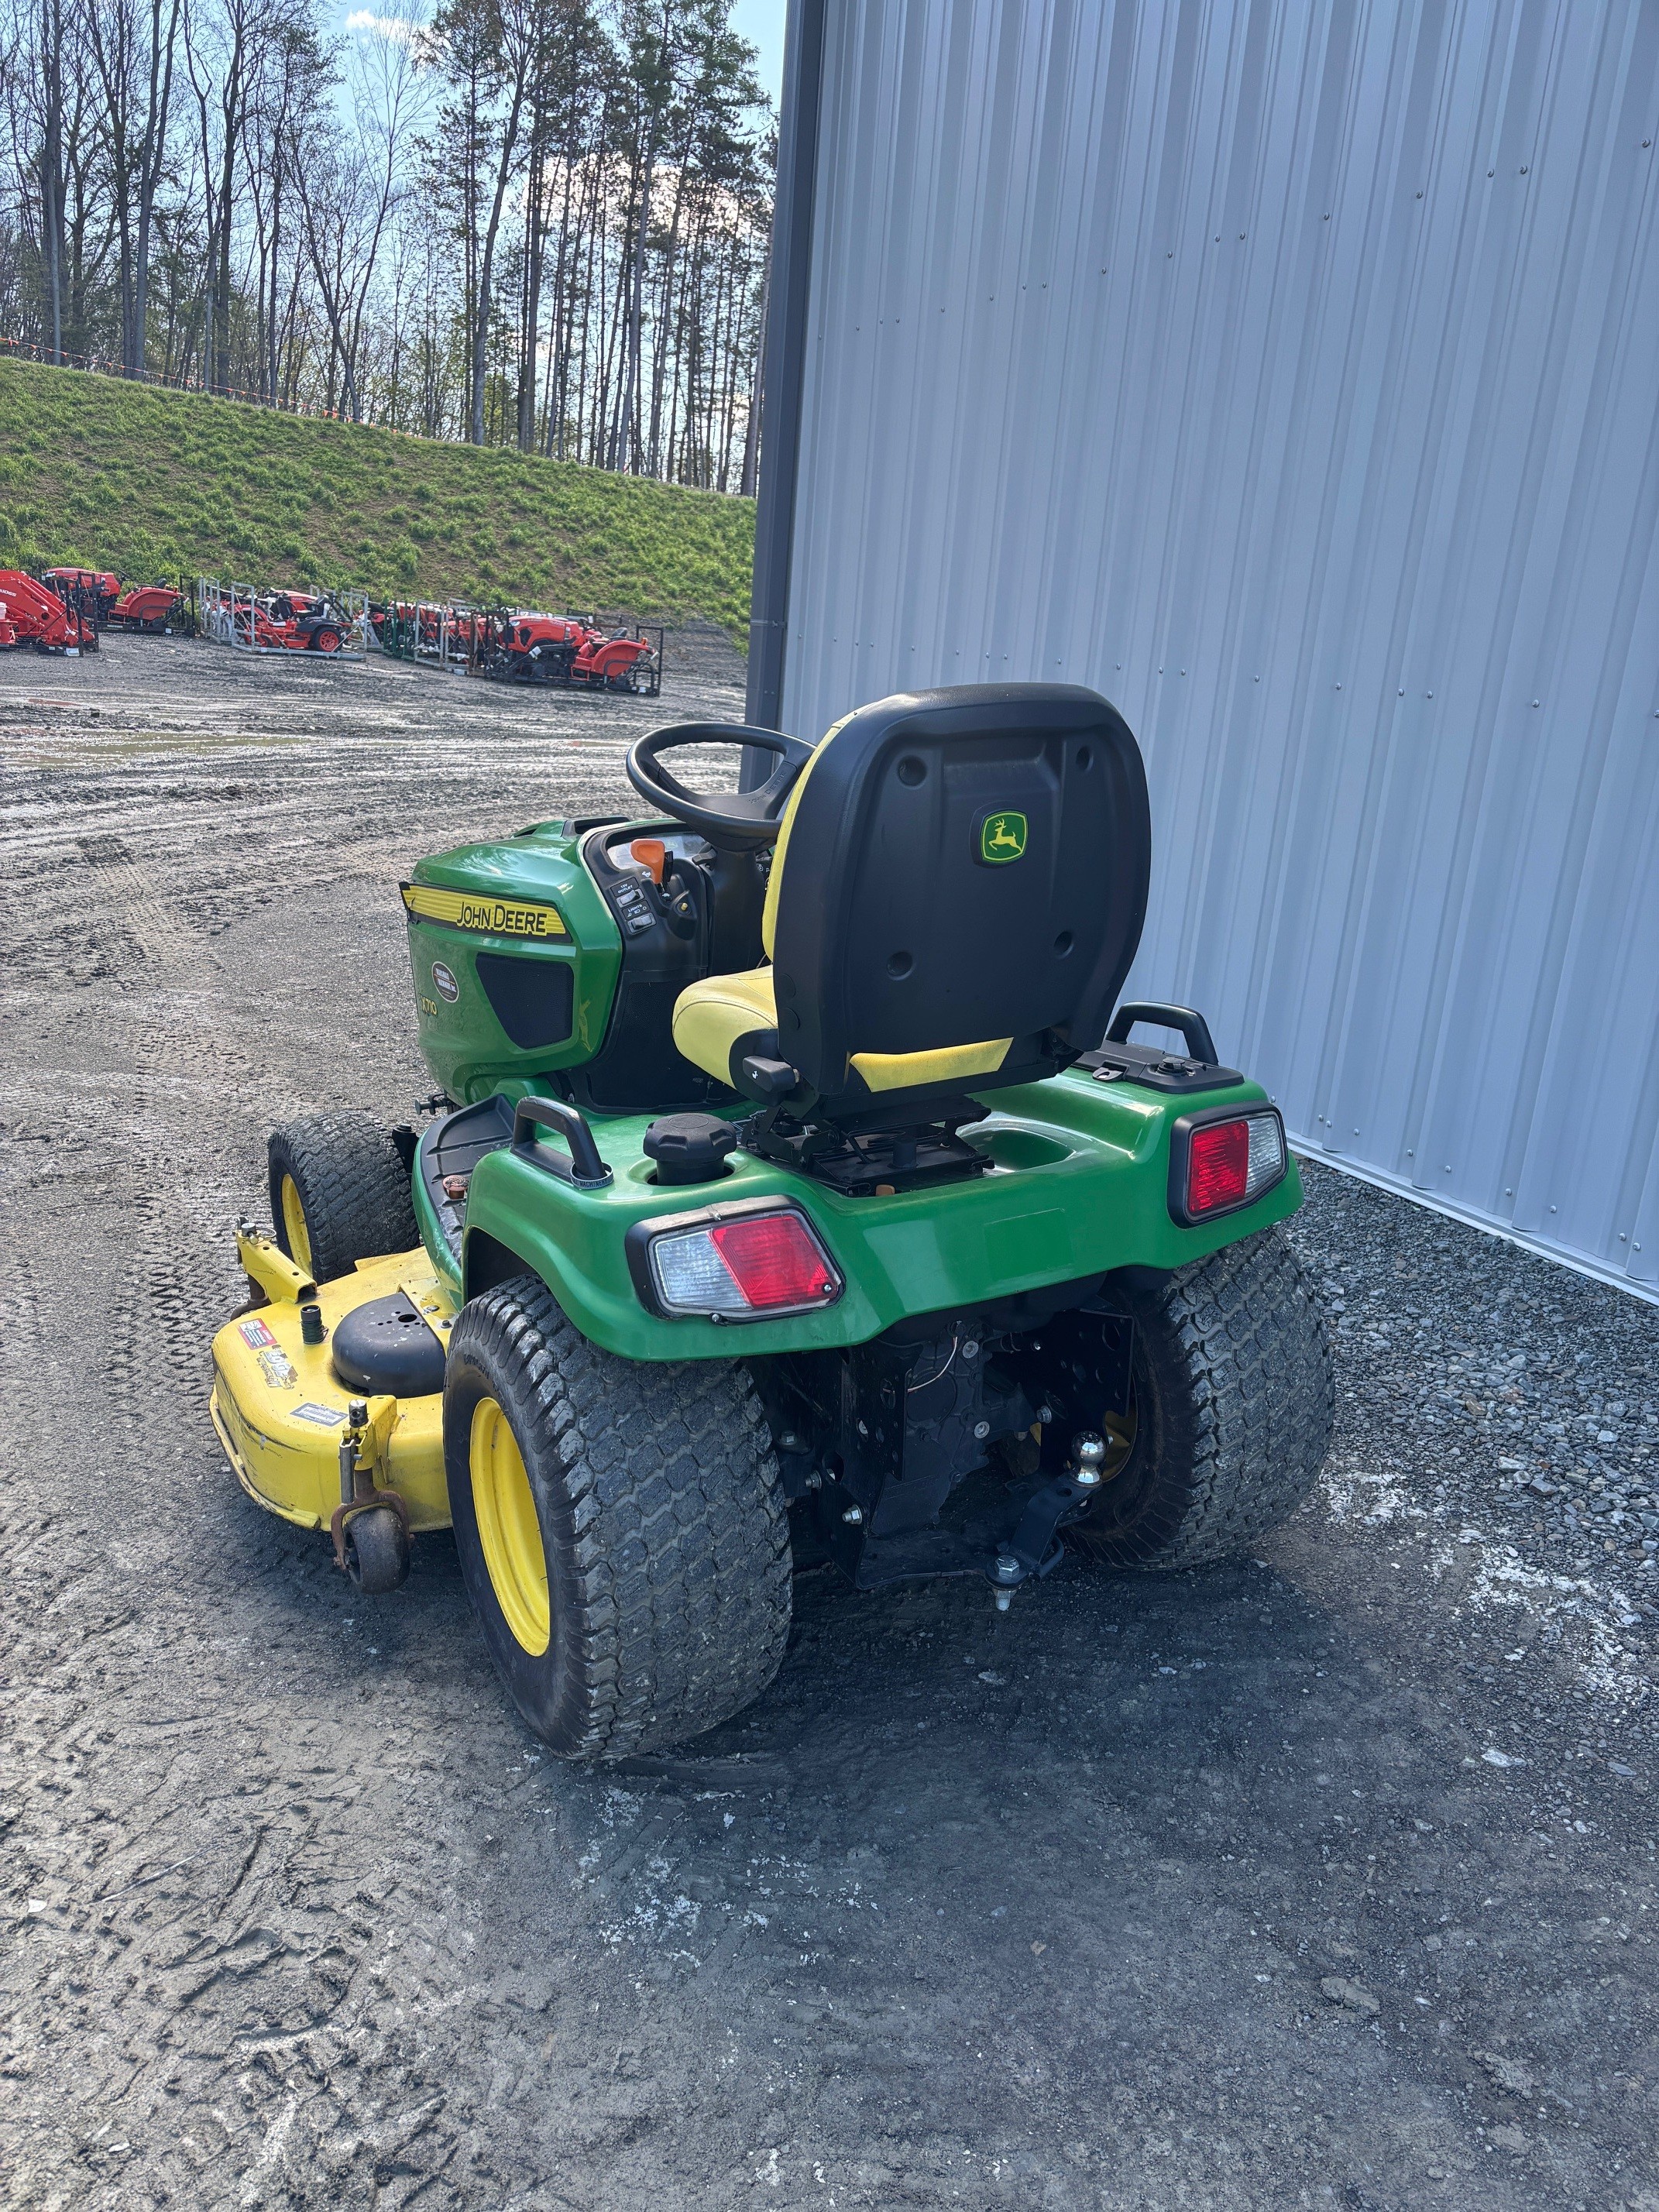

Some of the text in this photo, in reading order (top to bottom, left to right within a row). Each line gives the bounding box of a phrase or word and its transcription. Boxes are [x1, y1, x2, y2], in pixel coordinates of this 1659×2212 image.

[764, 770, 786, 795] DEERE
[617, 884, 633, 894] OUTLET
[628, 904, 643, 912] LIGHTS
[456, 902, 548, 933] JOHN DEERE
